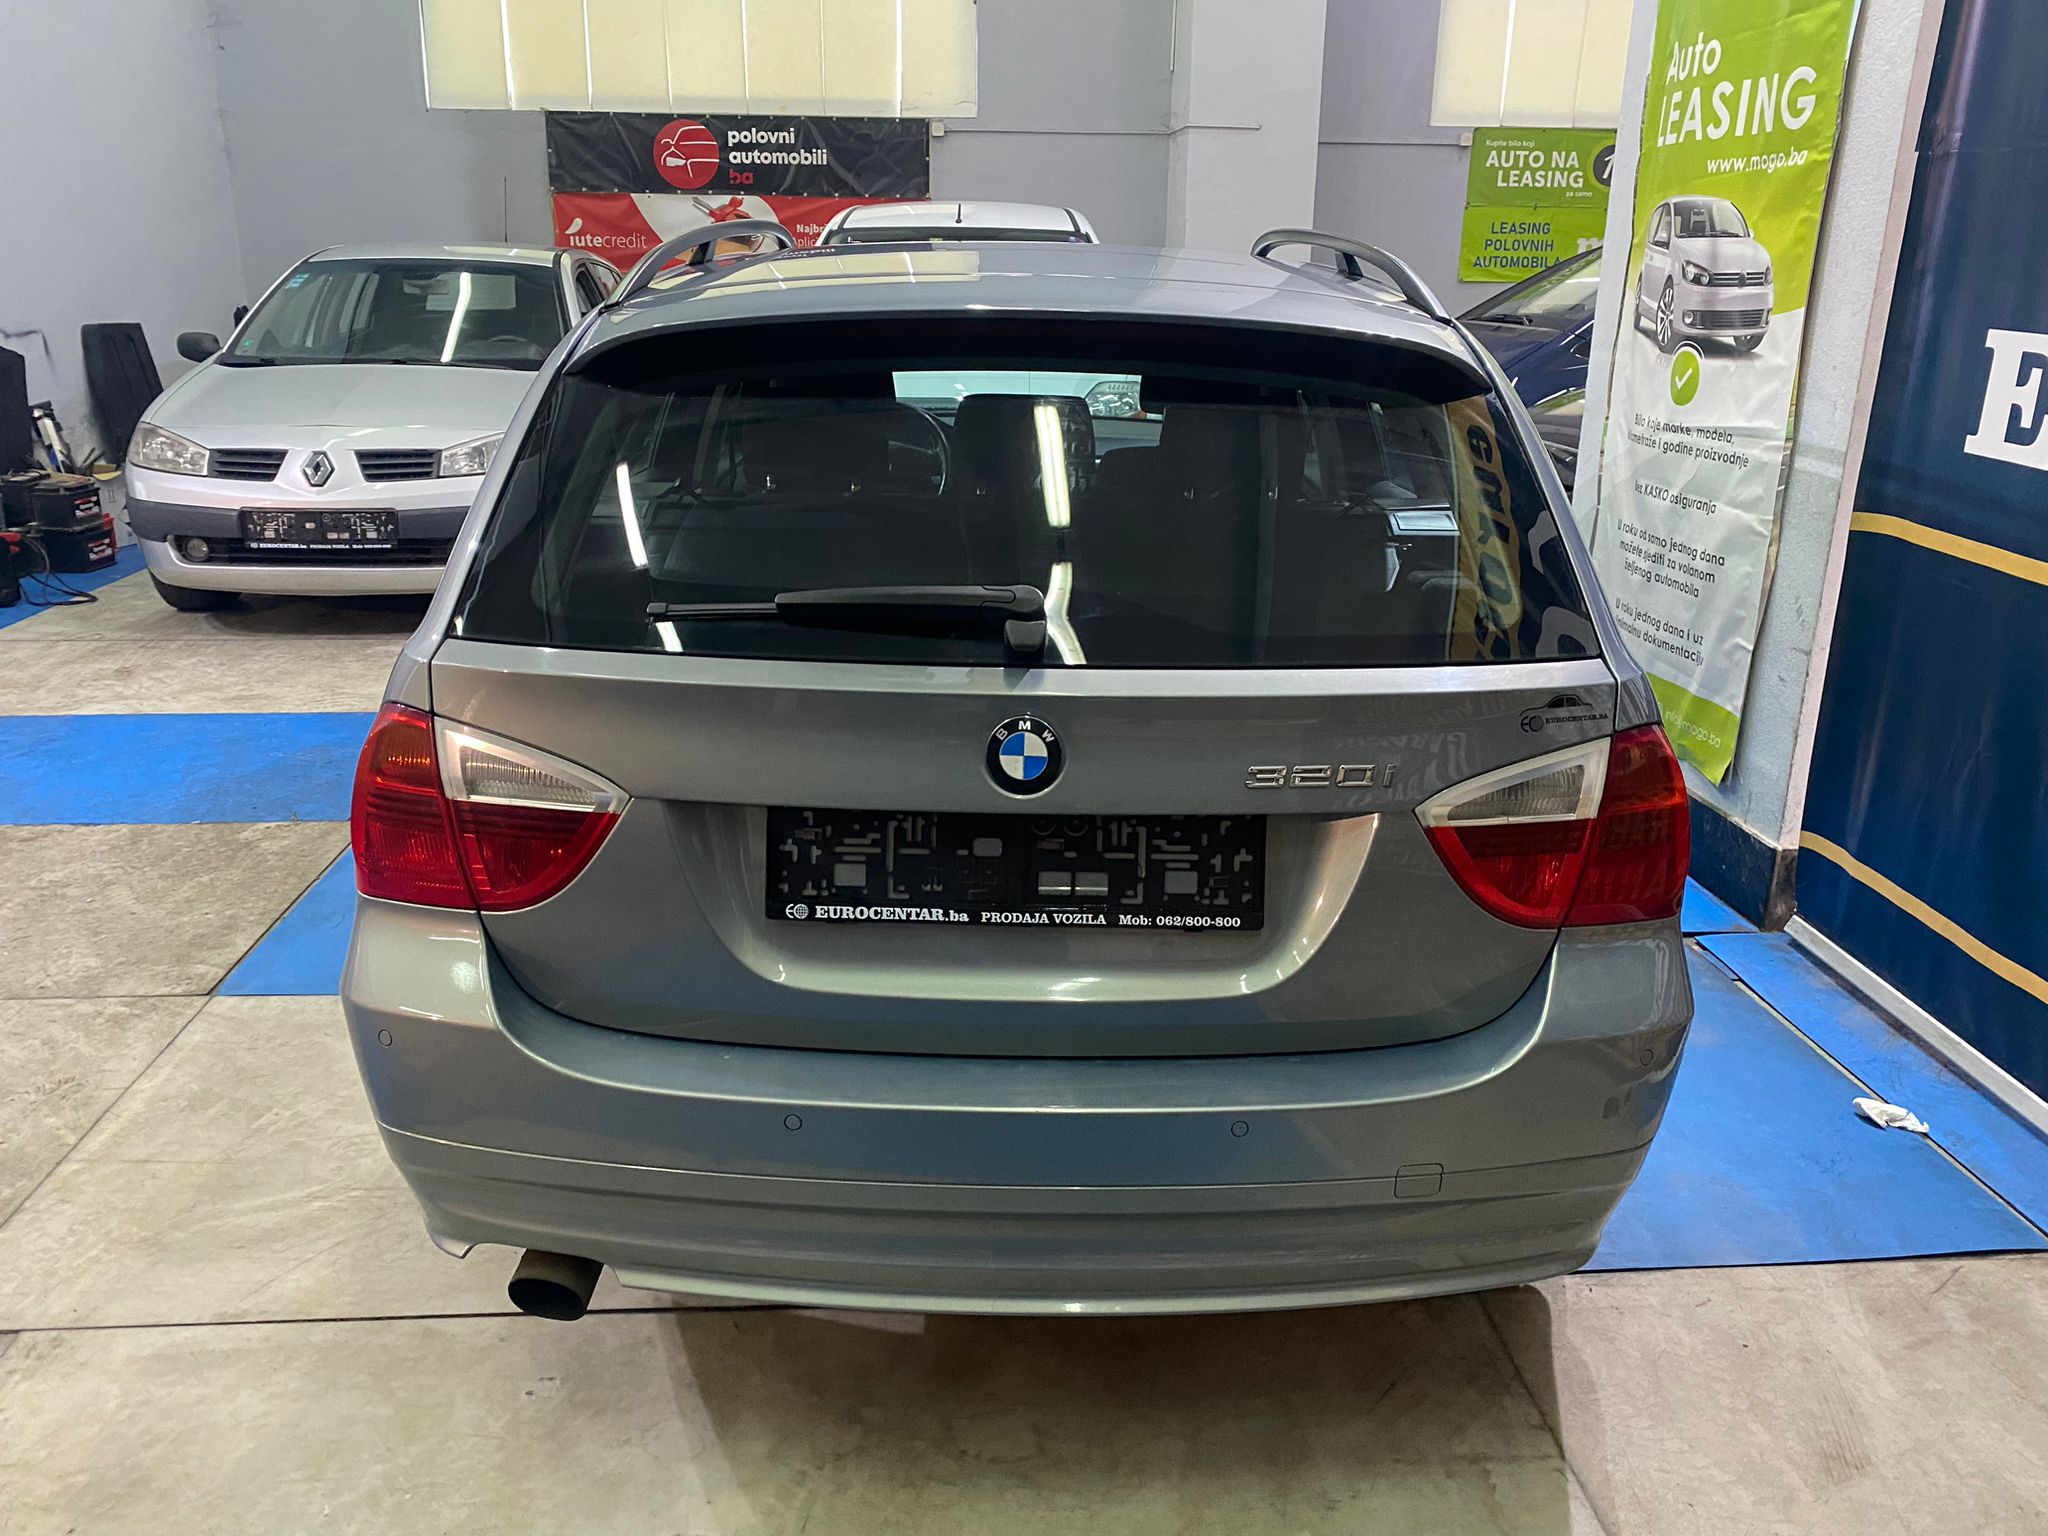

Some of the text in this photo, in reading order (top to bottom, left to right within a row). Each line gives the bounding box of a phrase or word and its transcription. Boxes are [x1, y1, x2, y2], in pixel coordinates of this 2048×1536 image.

[1666, 32, 1722, 85] Auto
[1657, 66, 1817, 147] LEASING
[727, 127, 795, 147] polovni
[728, 148, 828, 165] automobili
[1485, 150, 1580, 169] AUTO NA
[1707, 147, 1808, 174] www.mogo.ba
[1497, 170, 1584, 188] LEASING
[569, 229, 647, 249] iutecredit
[796, 223, 827, 235] Najbr
[1491, 221, 1551, 235] LEASING
[1484, 239, 1554, 251] POLOVNIH
[1473, 255, 1563, 268] AUTOMOBILA
[1646, 415, 1661, 432] koje
[1696, 427, 1735, 445] modela,
[1662, 441, 1694, 455] godine
[1694, 446, 1750, 469] proizvodnje
[1643, 484, 1669, 501] KASKO
[1669, 493, 1717, 515] osiguranja
[1622, 522, 1639, 537] roku
[1638, 527, 1647, 541] od
[1647, 532, 1667, 548] samo
[1669, 537, 1698, 561] jednog
[1699, 548, 1726, 567] dana
[1619, 540, 1716, 584] možete sjediti za volanom
[1624, 557, 1700, 598] željenog automobila
[1620, 602, 1634, 617] roku
[1632, 606, 1662, 632] jednog
[1662, 620, 1685, 639] dana
[1686, 628, 1691, 642] i
[1692, 633, 1705, 647] uz
[1642, 630, 1705, 667] dokumentaciju
[995, 719, 1056, 742] BMW
[1545, 713, 1609, 724] EUROCENTAR.BA
[1245, 763, 1398, 789] 320i
[815, 905, 969, 922] EUROCENTAR.ba
[980, 912, 1049, 923] PRODAJA
[1052, 914, 1107, 925] VOZILA
[1118, 914, 1152, 926] Mob:
[1156, 916, 1241, 927] 062/800-800
